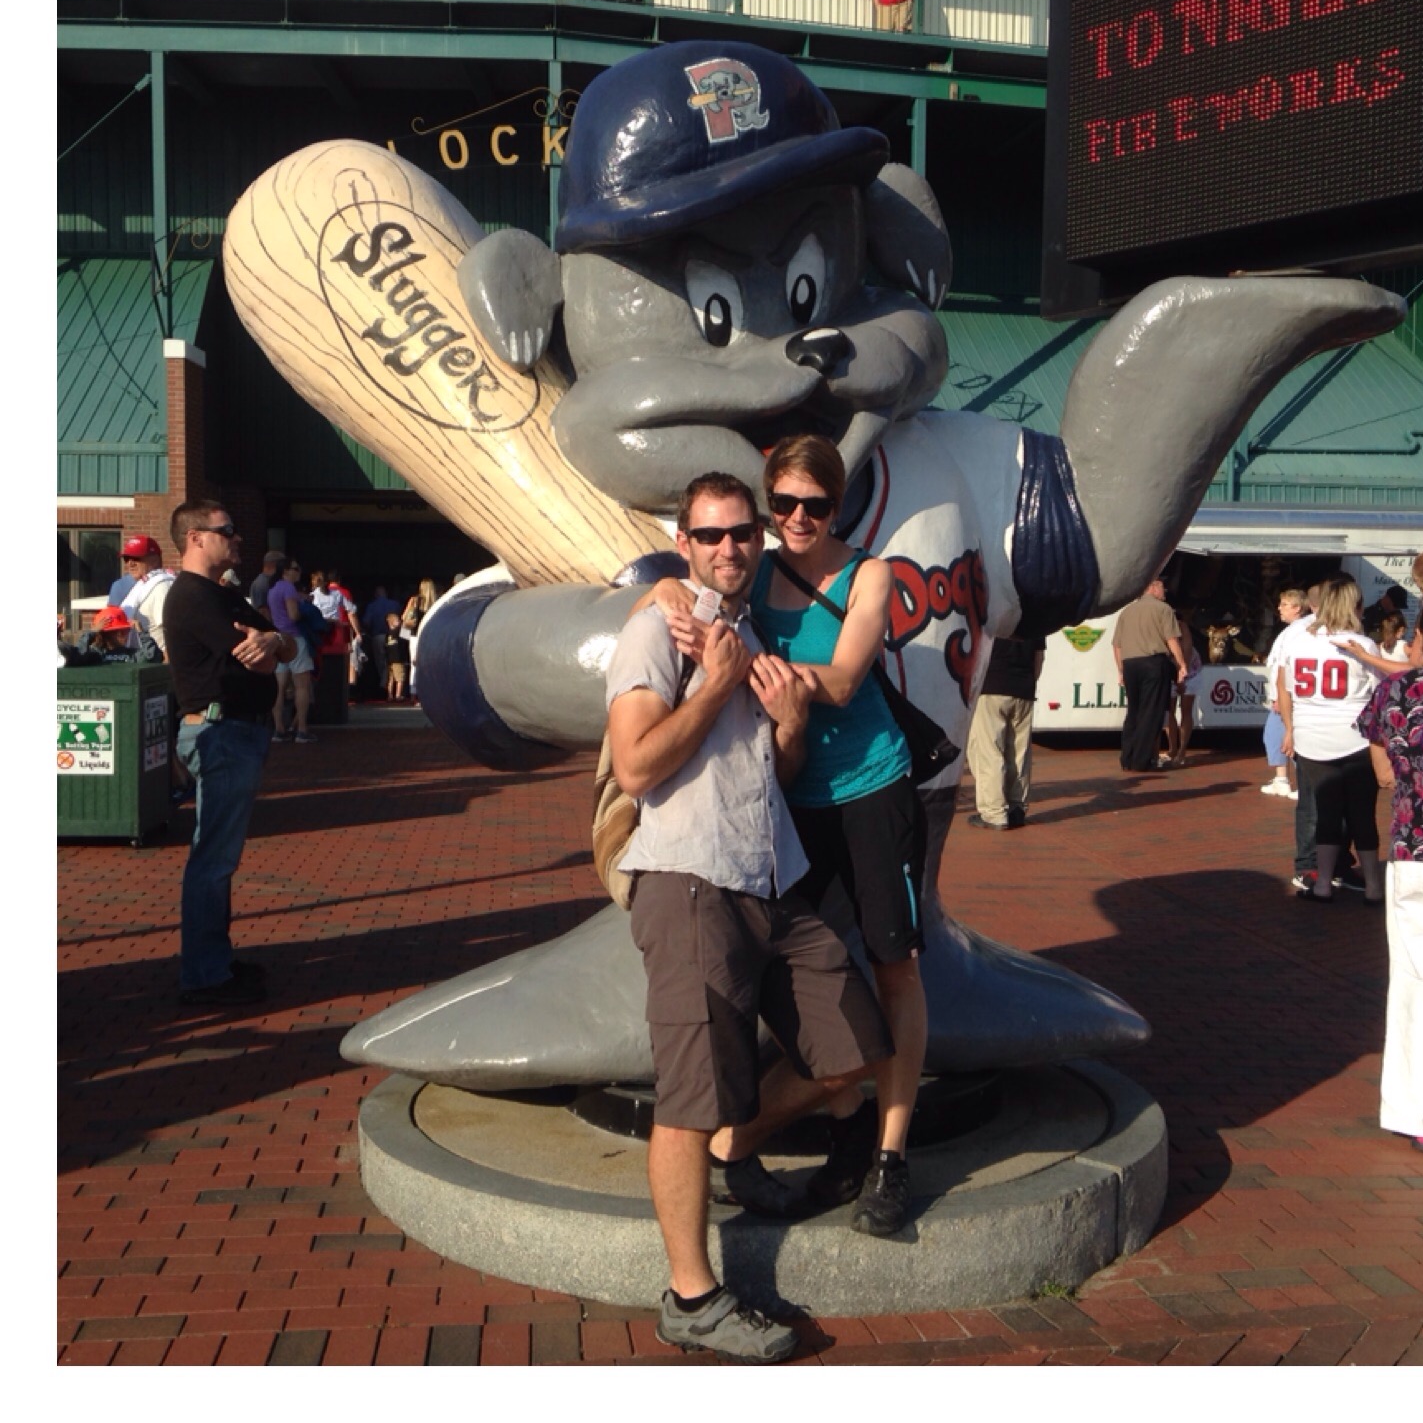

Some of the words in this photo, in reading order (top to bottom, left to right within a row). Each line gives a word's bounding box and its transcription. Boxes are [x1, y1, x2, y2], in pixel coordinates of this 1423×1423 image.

[1084, 48, 1406, 163] FIREWORKS
[387, 123, 569, 170] OCK
[884, 549, 989, 709] Dogs
[1294, 657, 1350, 699] 50
